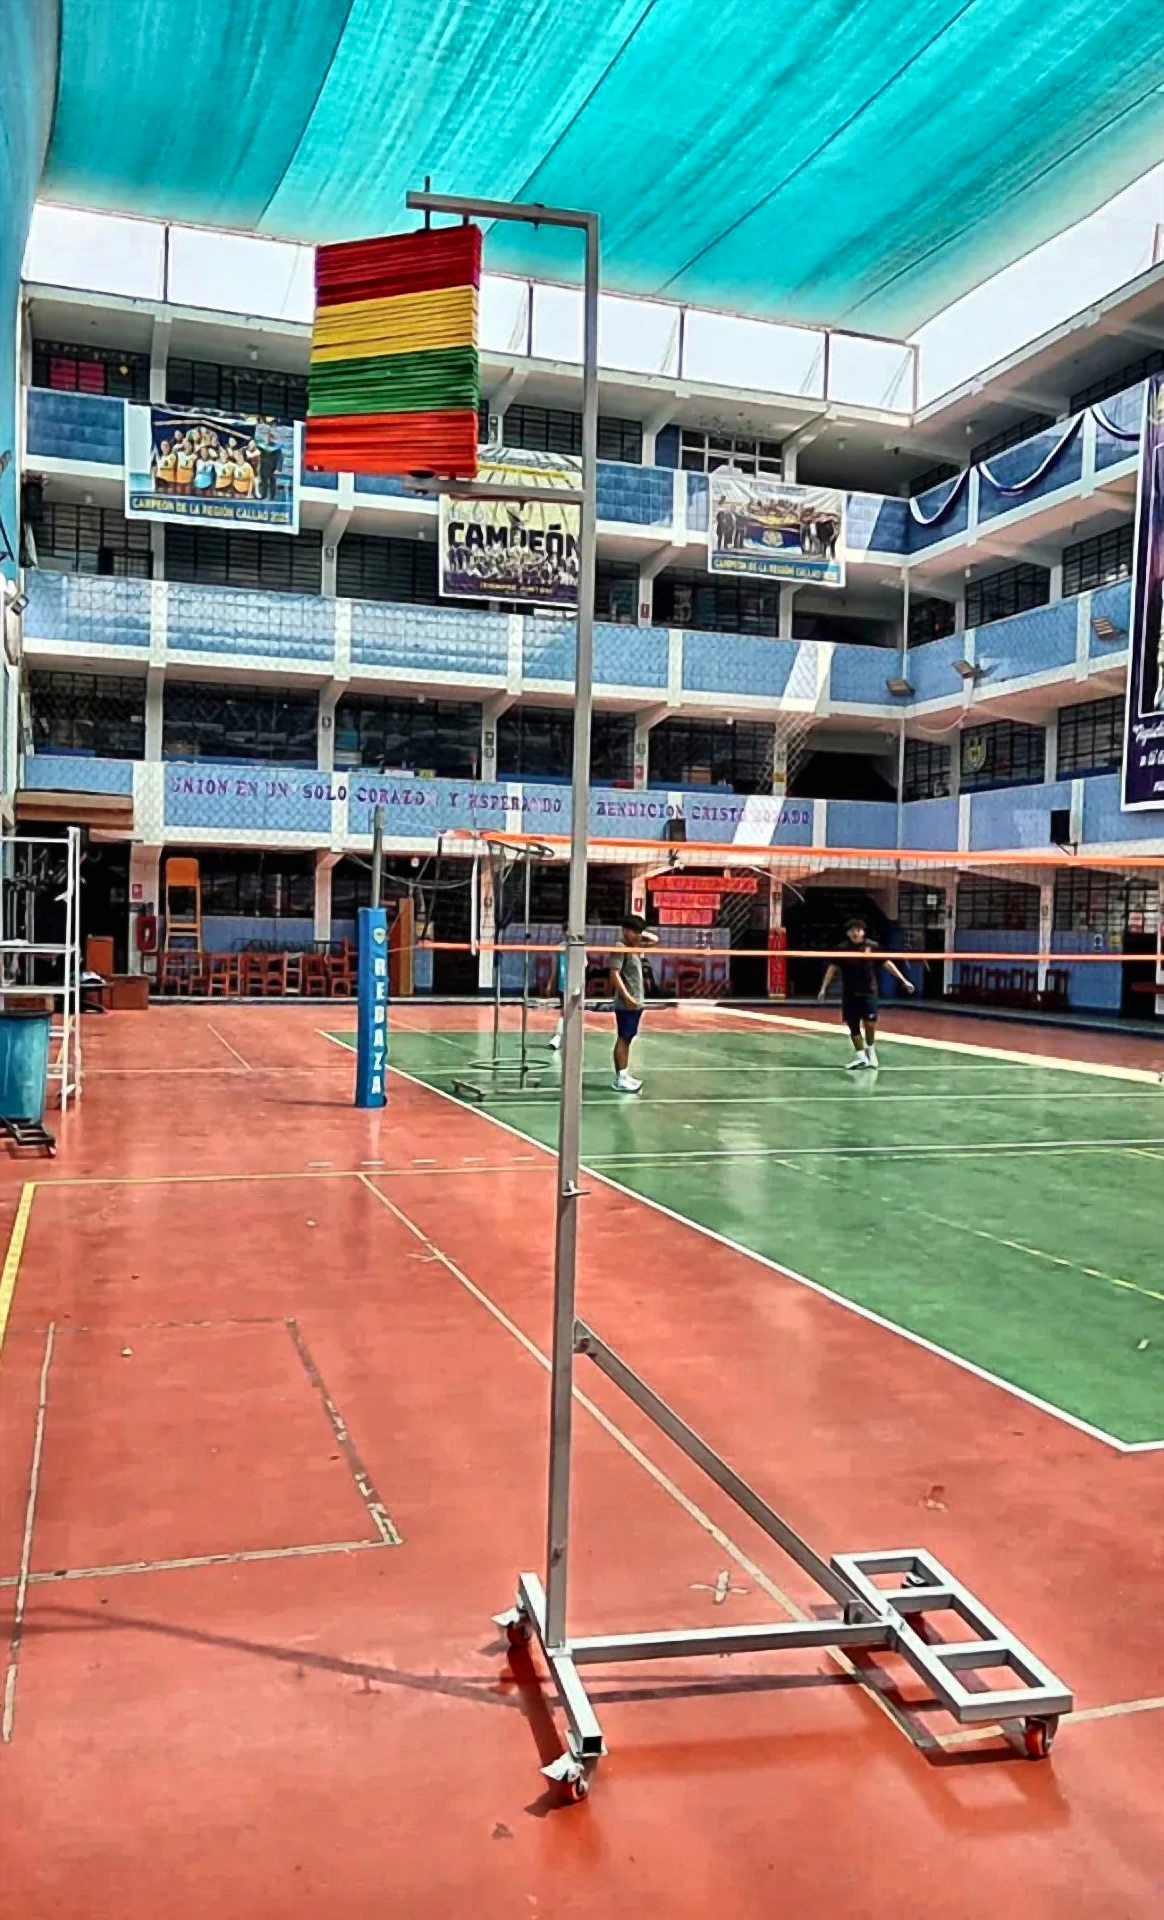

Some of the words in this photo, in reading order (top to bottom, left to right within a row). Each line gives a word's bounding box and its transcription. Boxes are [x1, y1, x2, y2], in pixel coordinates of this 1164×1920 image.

[176, 501, 187, 512] DE
[189, 503, 201, 515] LA
[236, 507, 269, 520] CALLAO
[447, 522, 579, 560] CAMPEÓN
[235, 779, 259, 798] EN
[302, 783, 347, 801] SOLO
[355, 787, 439, 806] CORAZON
[449, 792, 460, 807] Y
